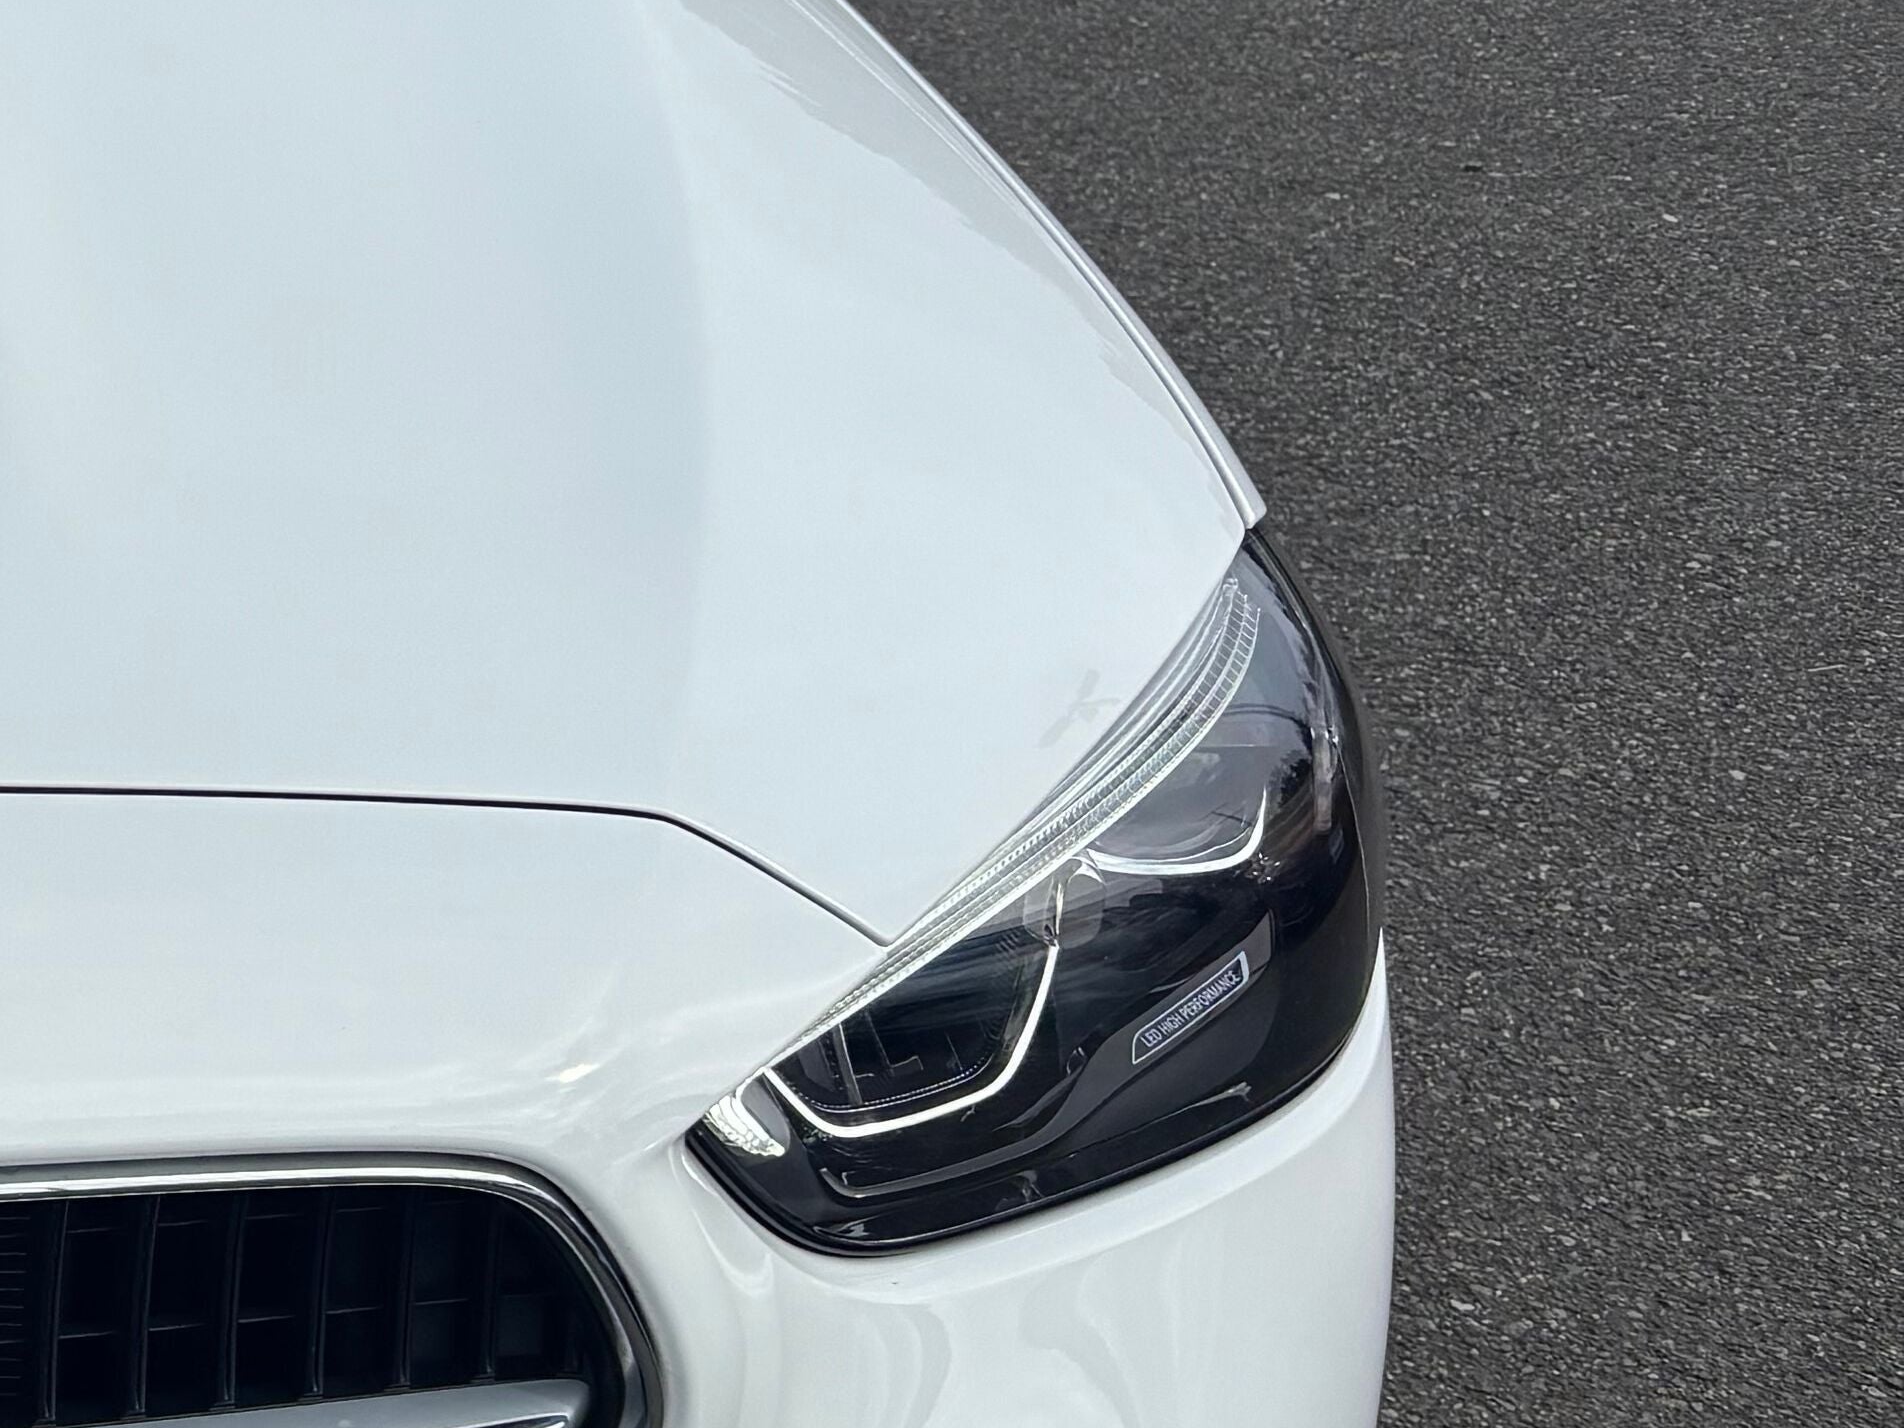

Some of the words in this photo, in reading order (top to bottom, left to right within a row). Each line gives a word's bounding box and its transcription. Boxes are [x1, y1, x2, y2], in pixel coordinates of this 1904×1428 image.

[1140, 1028, 1163, 1048] LED
[1157, 1012, 1185, 1037] HIGH
[1178, 970, 1241, 1021] PERFORMANCE
